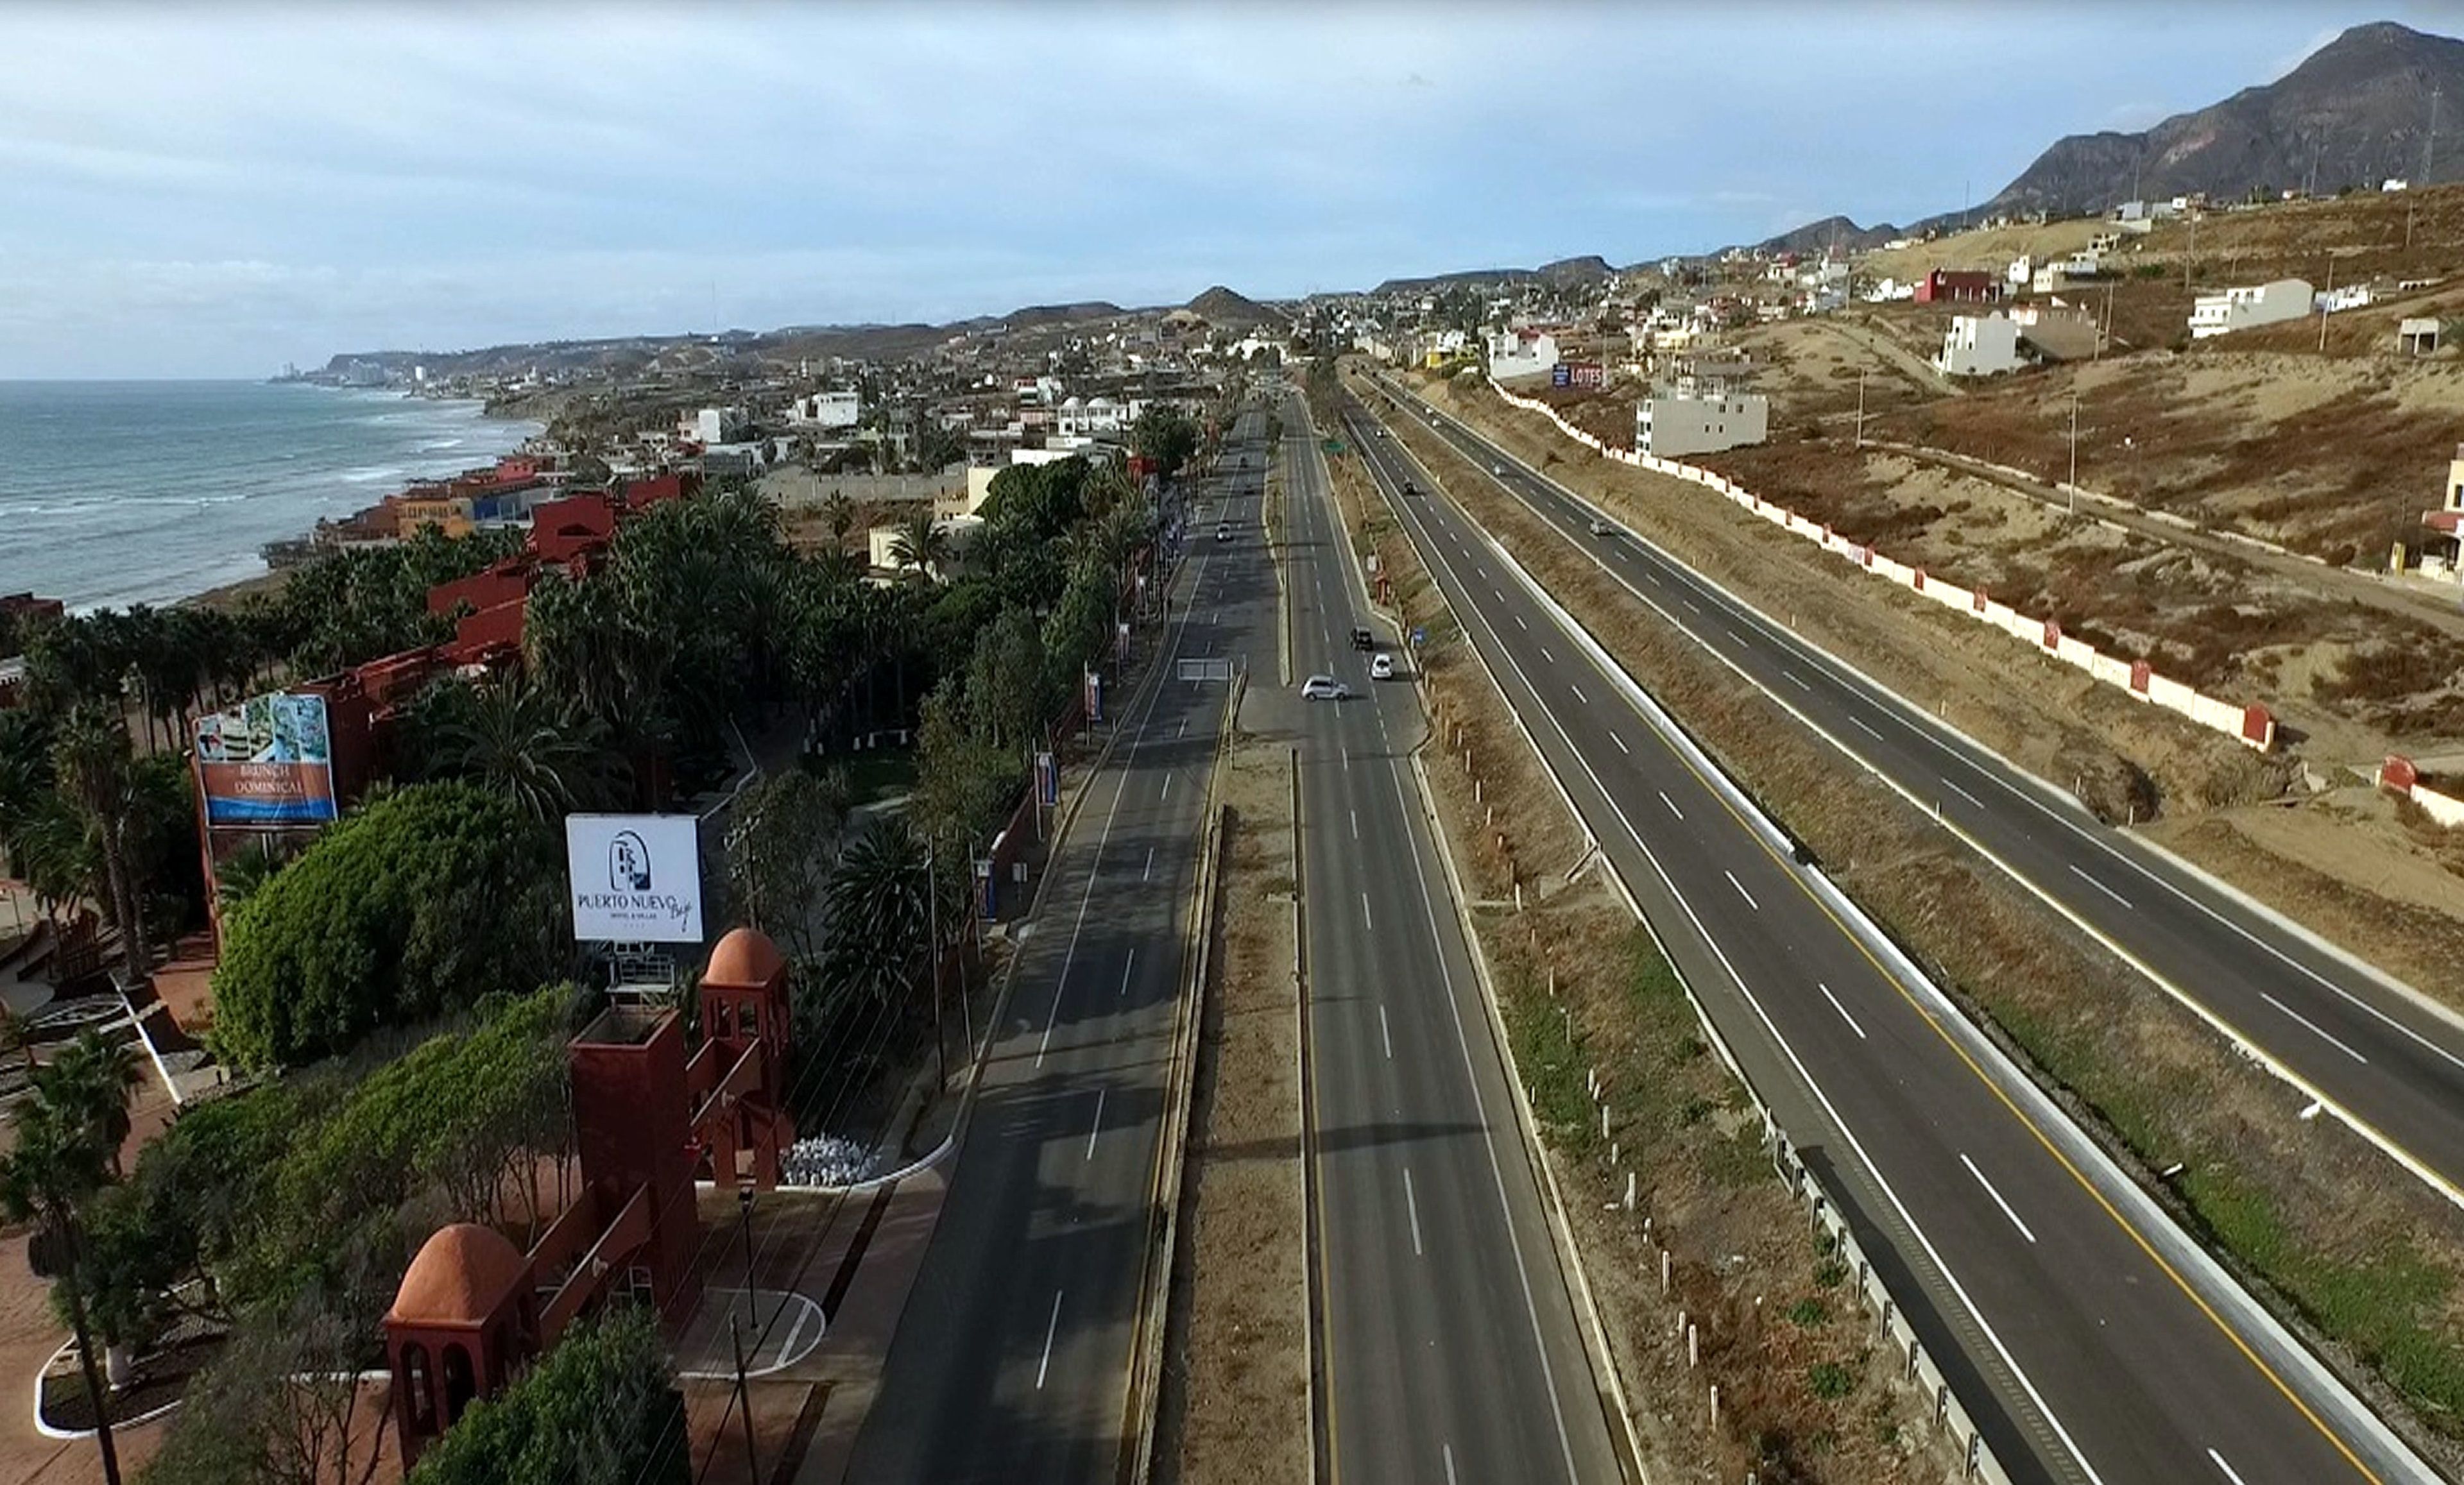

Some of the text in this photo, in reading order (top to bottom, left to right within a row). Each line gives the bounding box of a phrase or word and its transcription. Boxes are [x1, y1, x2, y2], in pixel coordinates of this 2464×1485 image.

[1570, 368, 1602, 383] LOTES
[240, 763, 290, 777] BRUNCH
[234, 781, 303, 793] DOMINICAL
[578, 894, 676, 910] PUERTO NUEVO
